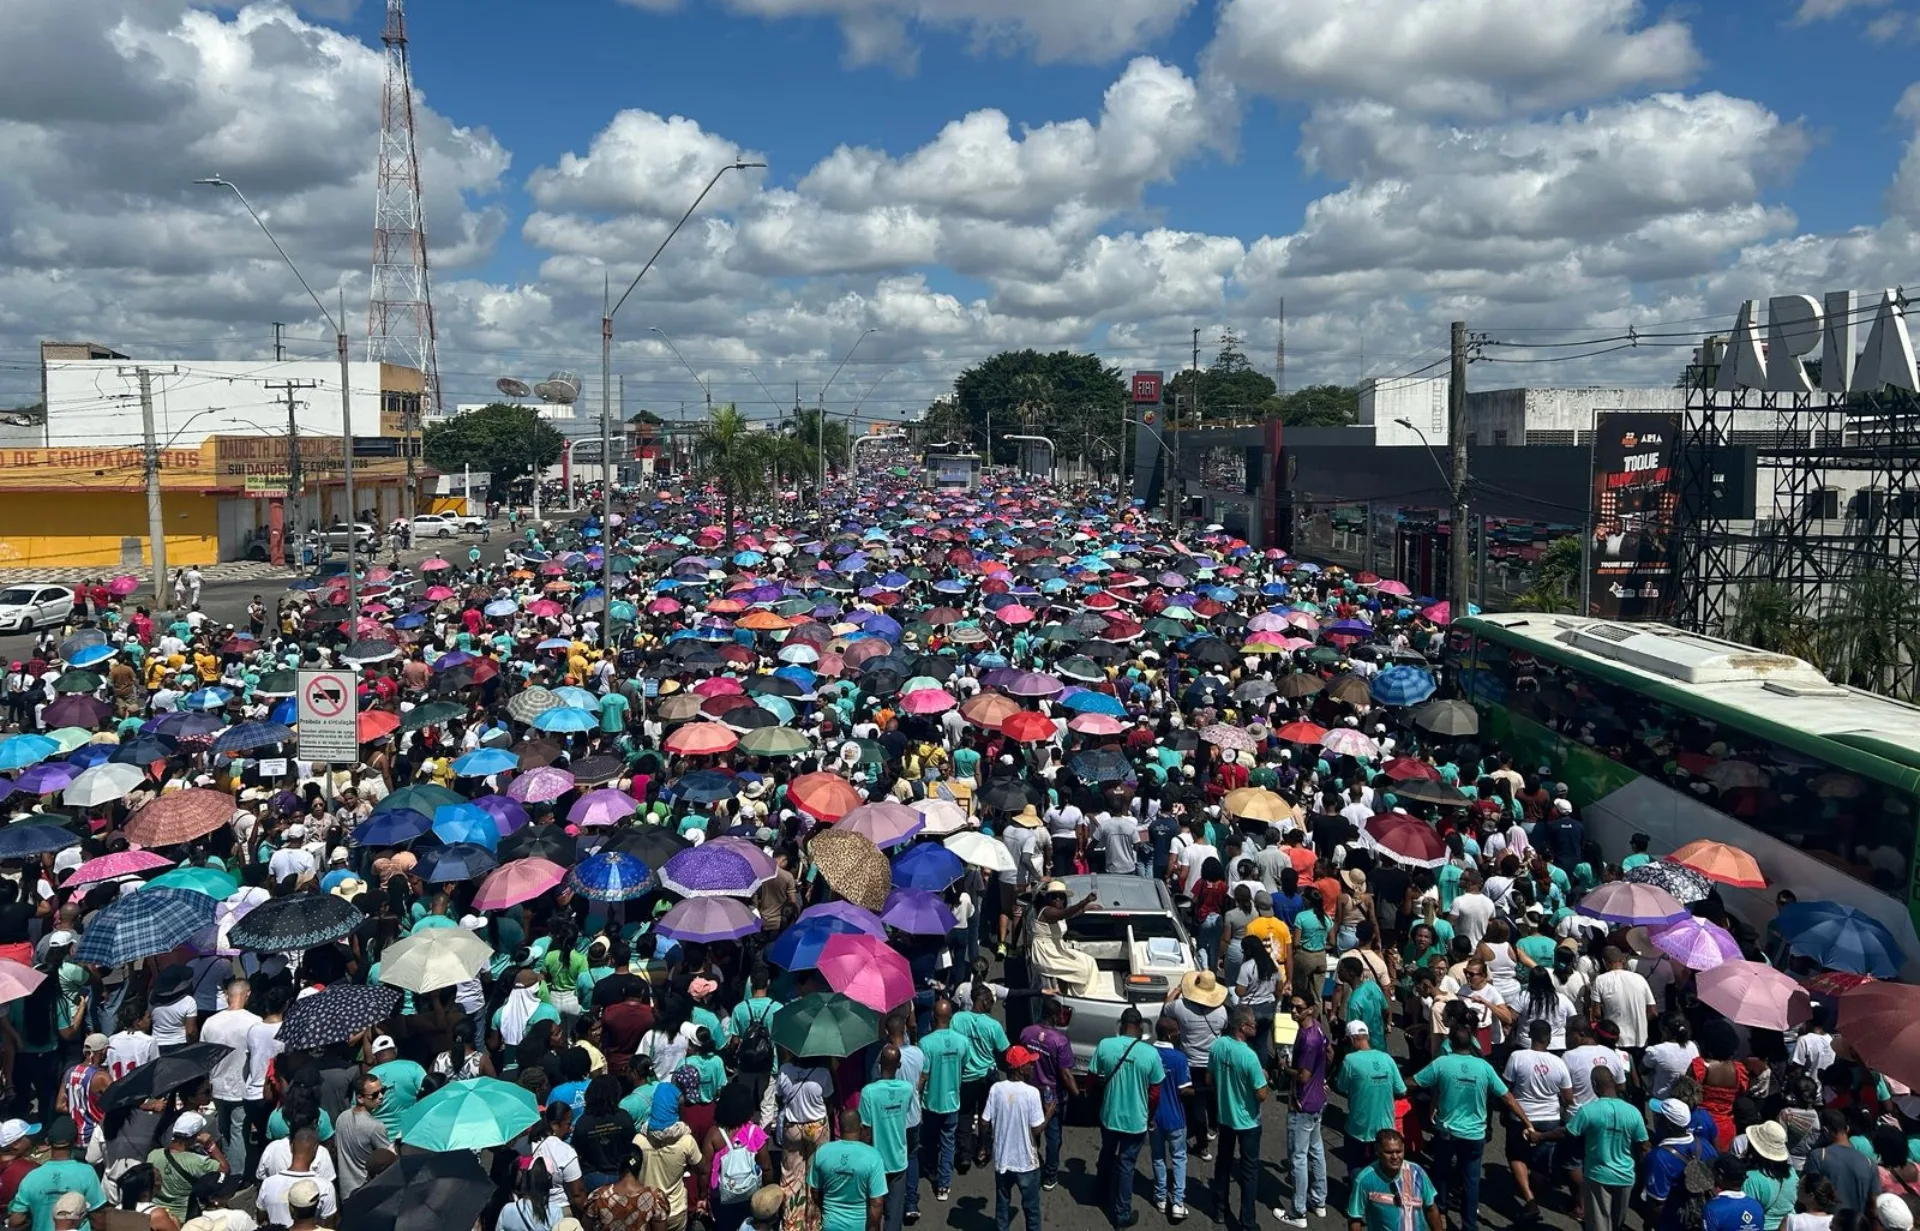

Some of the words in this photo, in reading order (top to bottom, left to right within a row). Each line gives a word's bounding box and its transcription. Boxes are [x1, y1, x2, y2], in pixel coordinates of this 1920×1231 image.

[1714, 288, 1920, 393] ARIA
[1137, 381, 1156, 396] FIAT
[13, 451, 37, 468] DE
